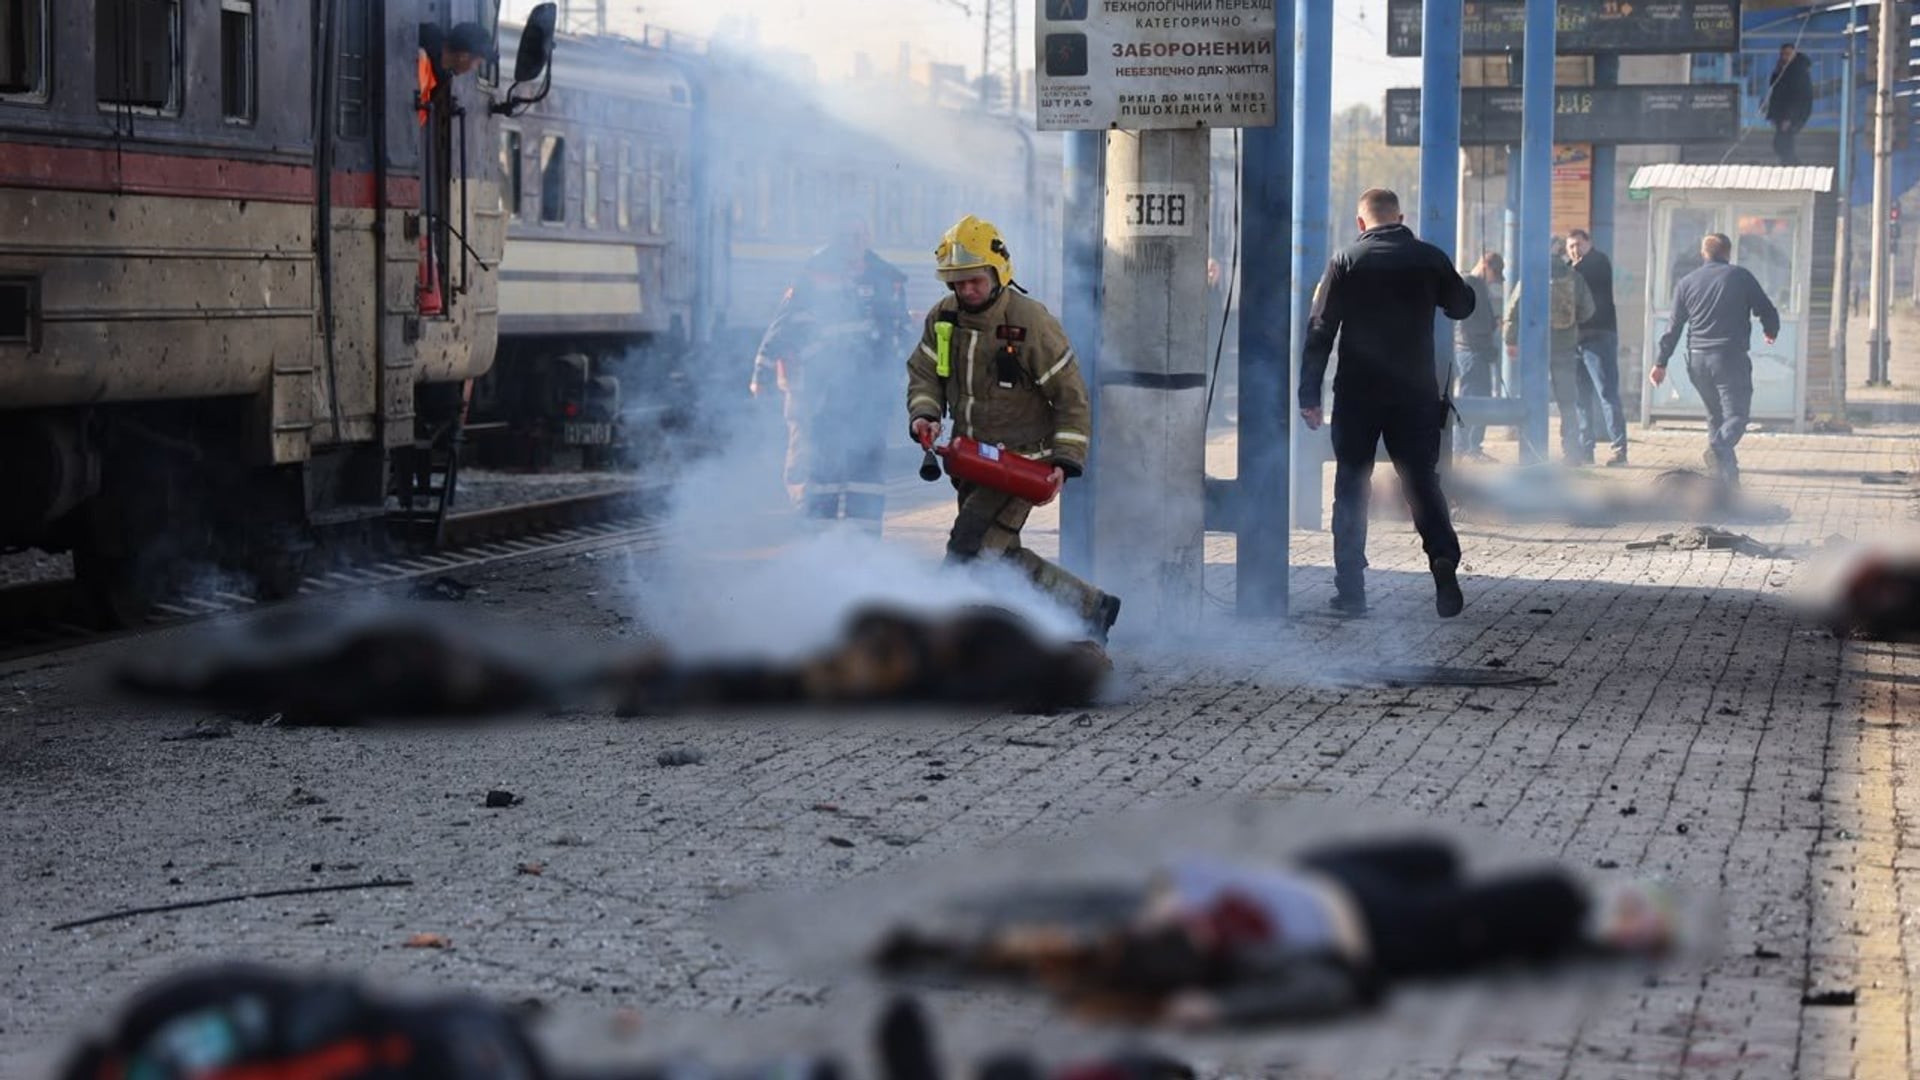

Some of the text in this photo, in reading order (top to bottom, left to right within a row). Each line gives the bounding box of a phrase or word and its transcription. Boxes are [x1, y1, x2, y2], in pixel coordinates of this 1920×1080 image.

[1216, 0, 1272, 11] ПЕРЕХІД
[1135, 15, 1241, 29] КАТЕГОРИЧНО
[1111, 37, 1272, 58] ЗАБОРОНЕНИЙ
[1115, 64, 1269, 78] НЕБЕЗПЕЧНО ДЛЯ ЖИТТЯ
[1041, 98, 1093, 108] ШТРАФ
[1119, 91, 1266, 104] ВИХІД ДО МІСТА ЧЕРЕЗ
[1121, 101, 1267, 116] ПІШОХІДНИЙ МІСТ
[1125, 193, 1186, 226] 388
